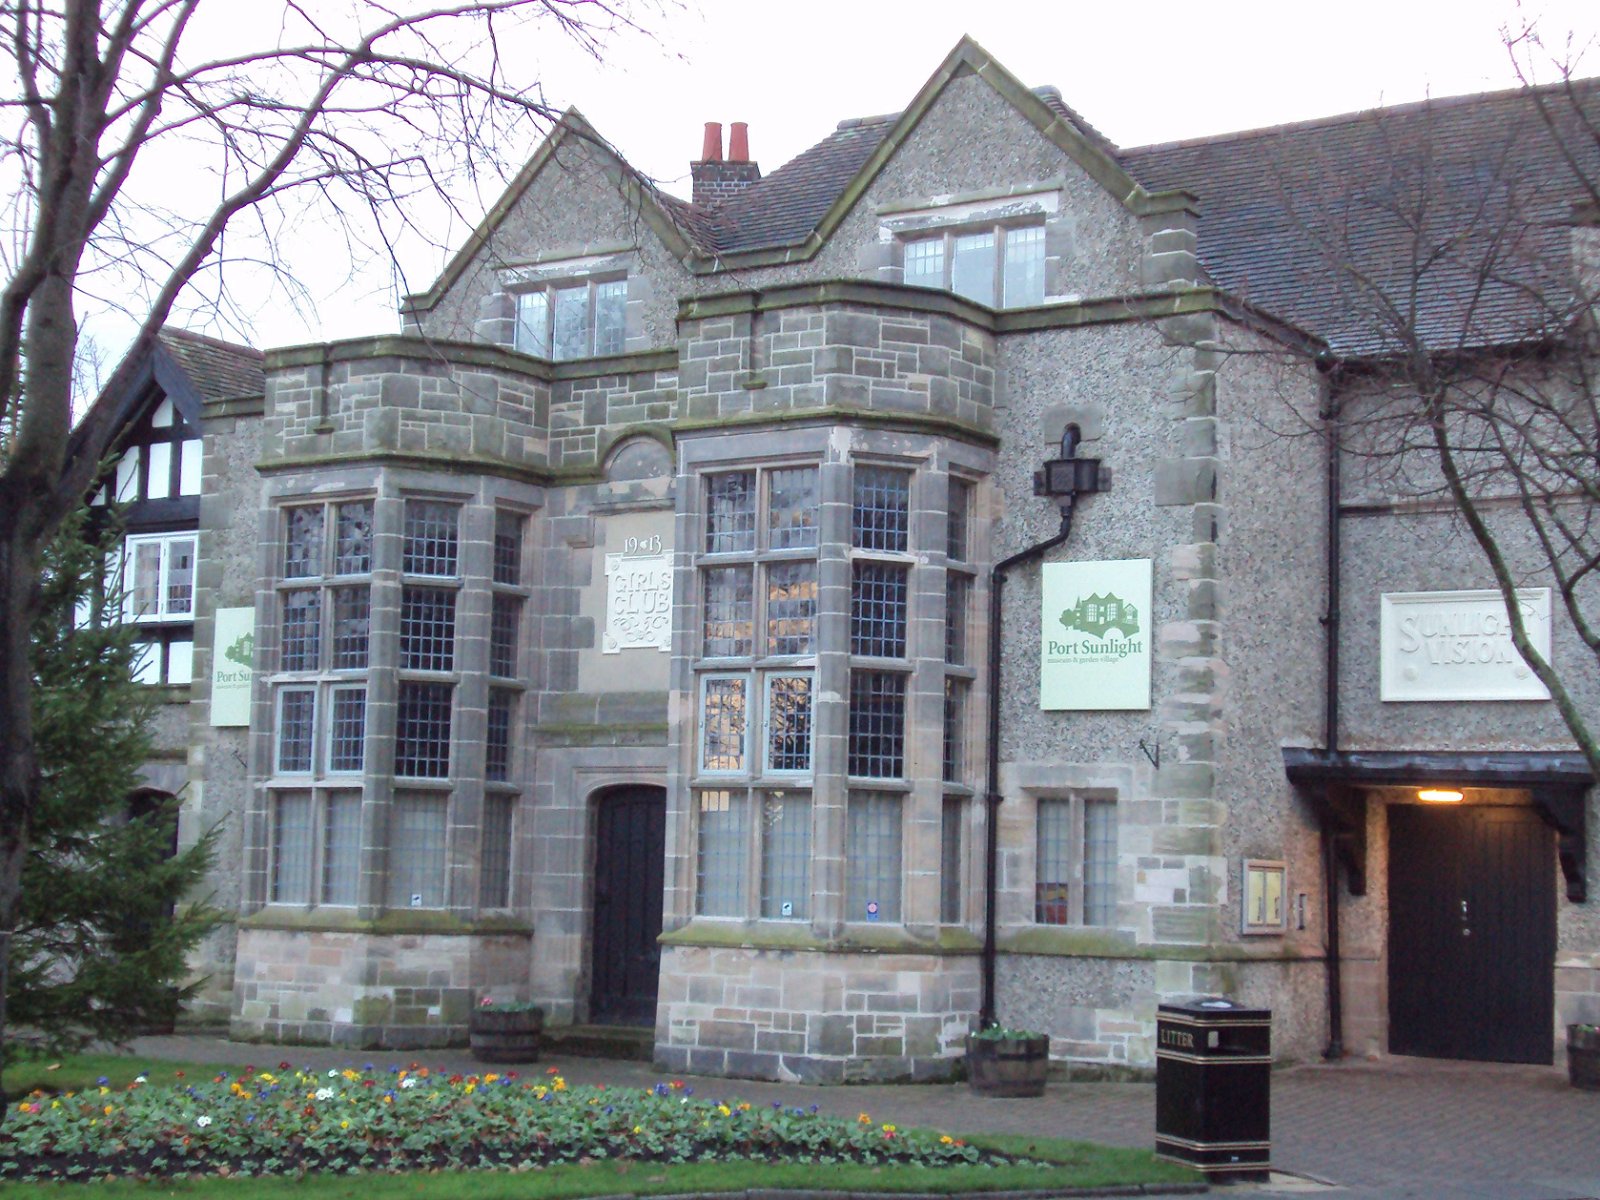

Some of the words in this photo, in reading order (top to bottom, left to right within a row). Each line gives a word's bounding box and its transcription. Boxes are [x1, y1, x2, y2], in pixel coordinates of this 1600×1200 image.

[624, 537, 638, 554] 19
[649, 534, 662, 555] 13
[615, 571, 671, 593] GIRLS
[614, 592, 670, 615] CLUB
[1048, 640, 1078, 655] Port
[1081, 638, 1143, 658] Sunlight
[216, 670, 237, 683] Port
[1161, 1028, 1194, 1048] LITTER
